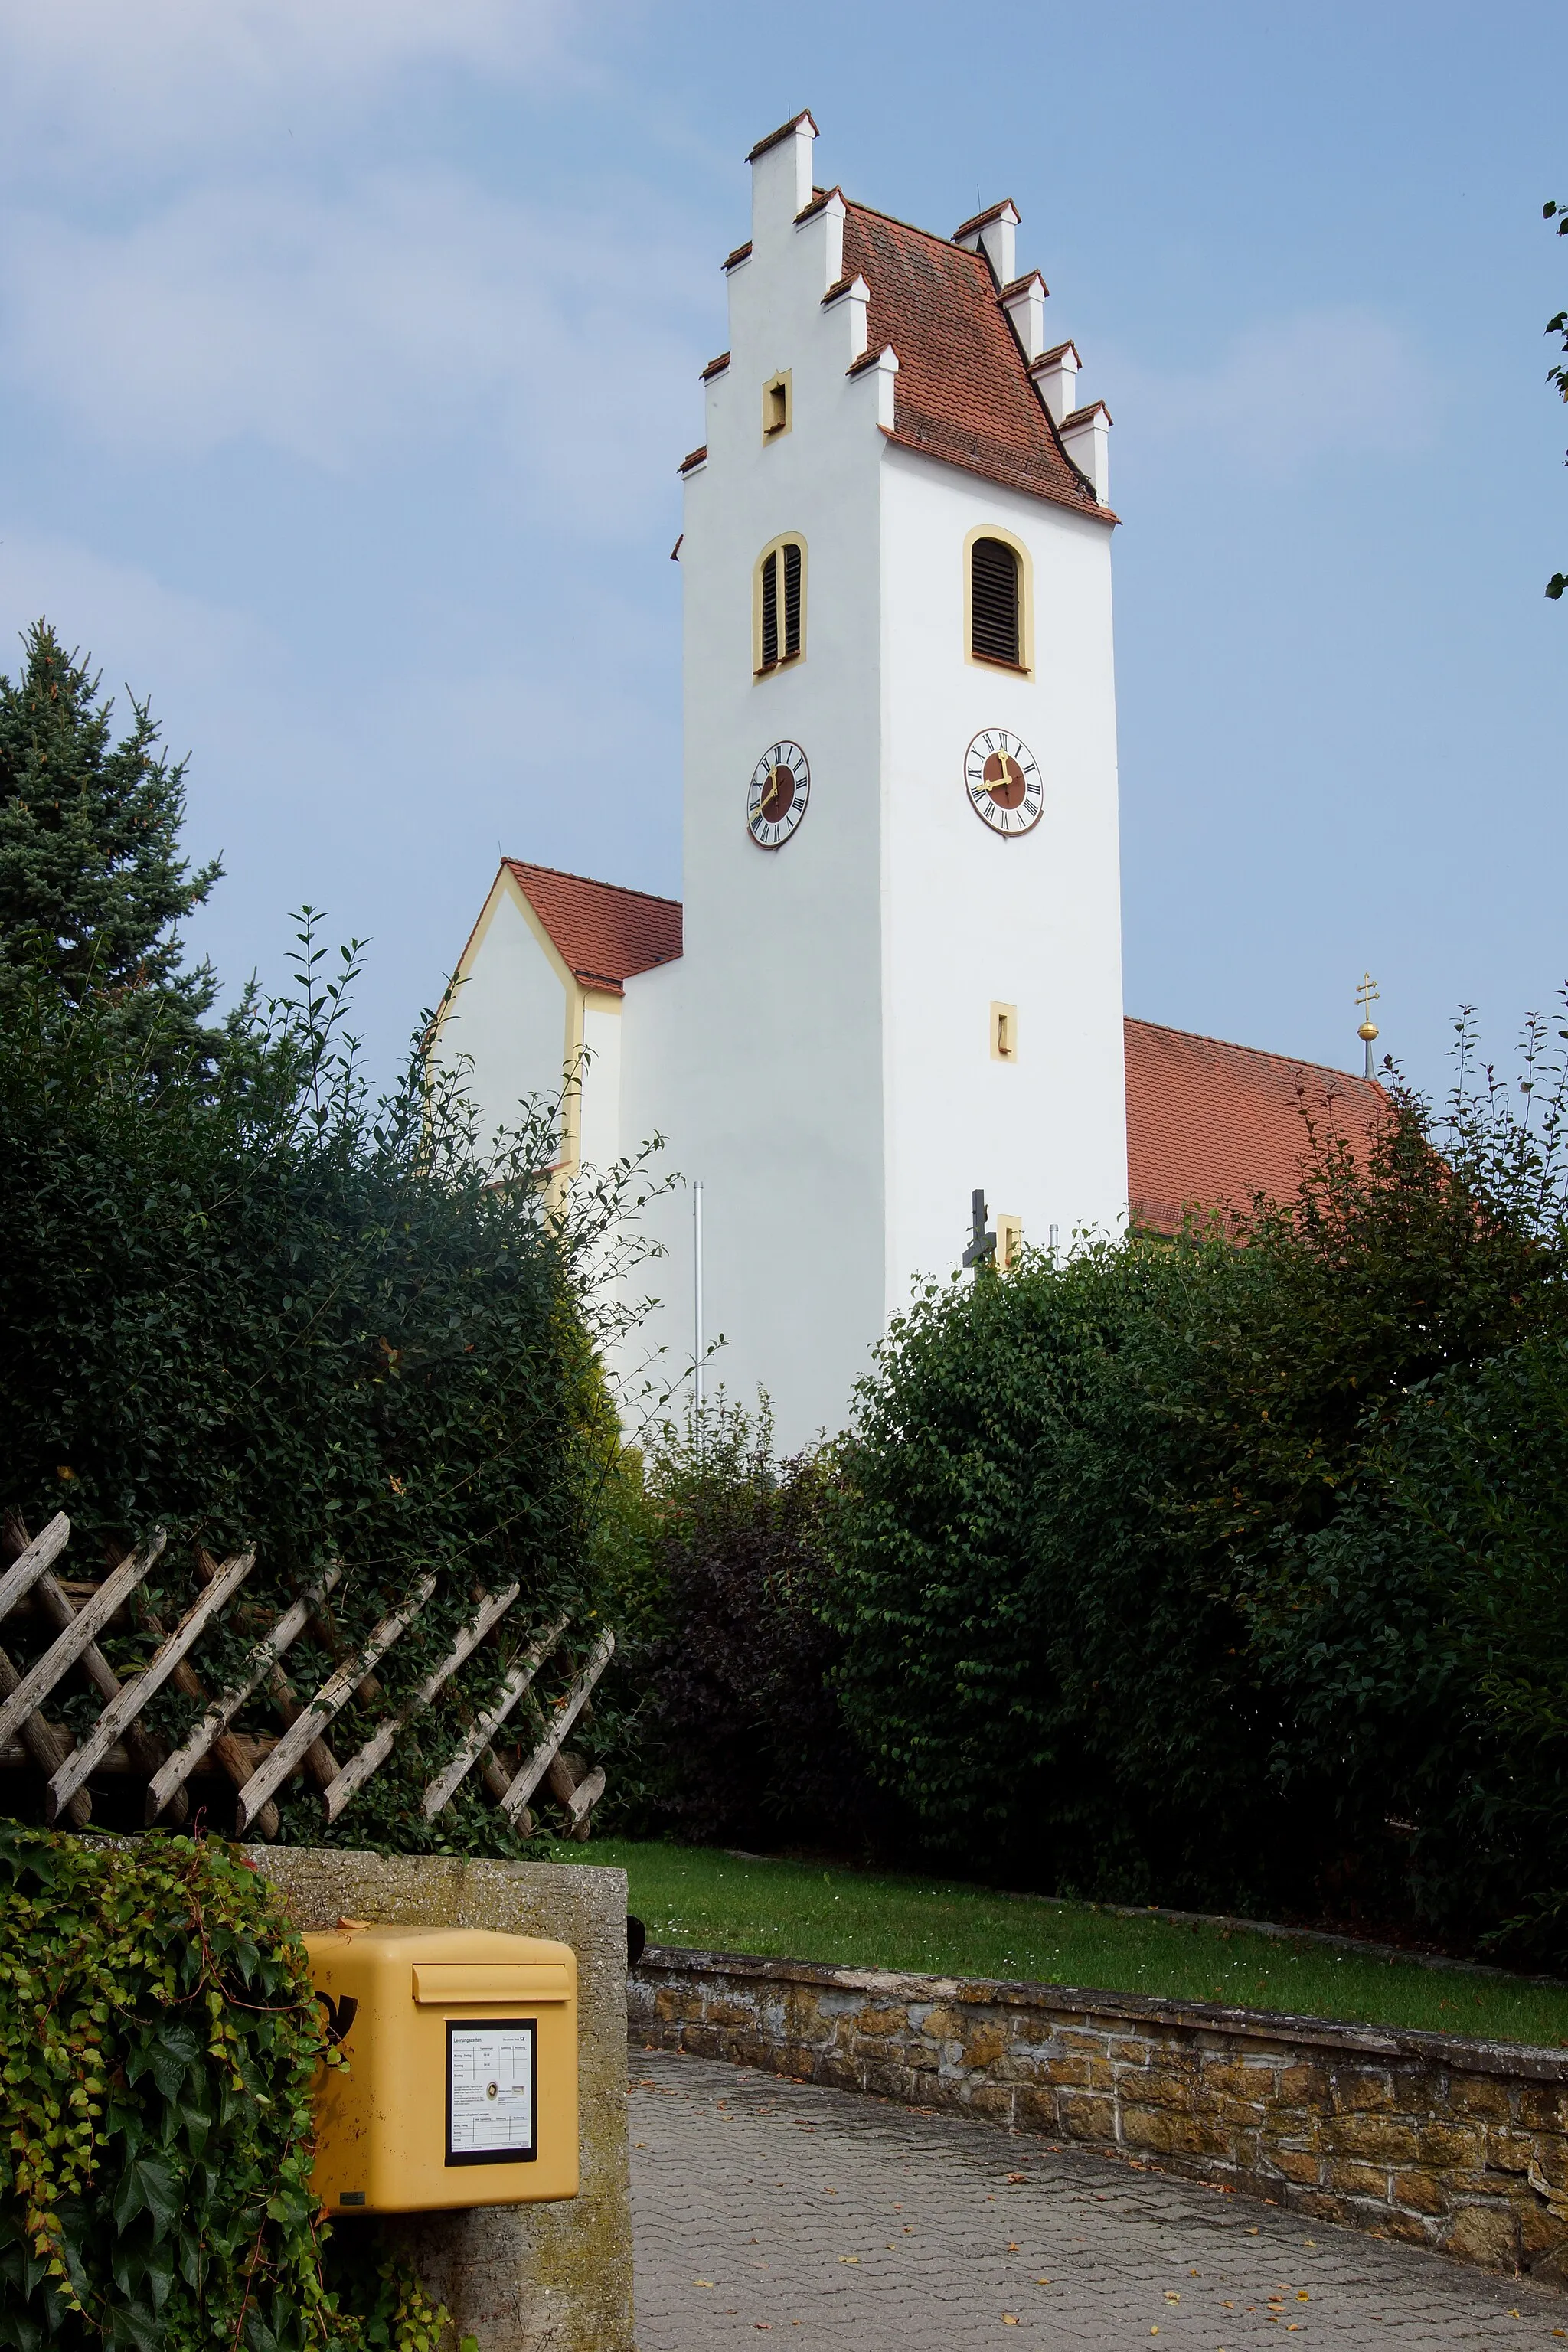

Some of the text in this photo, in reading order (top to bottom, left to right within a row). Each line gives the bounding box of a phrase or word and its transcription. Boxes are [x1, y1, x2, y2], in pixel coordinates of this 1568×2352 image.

[982, 733, 995, 753] XI
[998, 732, 1007, 751] XII
[786, 746, 793, 764] I
[971, 746, 985, 763] X
[1014, 743, 1023, 758] I
[793, 756, 804, 773] II
[968, 766, 982, 779] IX
[1023, 763, 1036, 773] II
[753, 779, 762, 790] X
[796, 776, 807, 790] III
[1028, 784, 1040, 795] III
[792, 796, 805, 812] IIII
[983, 801, 995, 821] VII
[1023, 798, 1038, 817] IIII
[786, 815, 794, 832] V
[1001, 810, 1009, 830] VI
[1016, 810, 1026, 829] V
[760, 823, 770, 843] VII
[774, 824, 780, 842] VI
